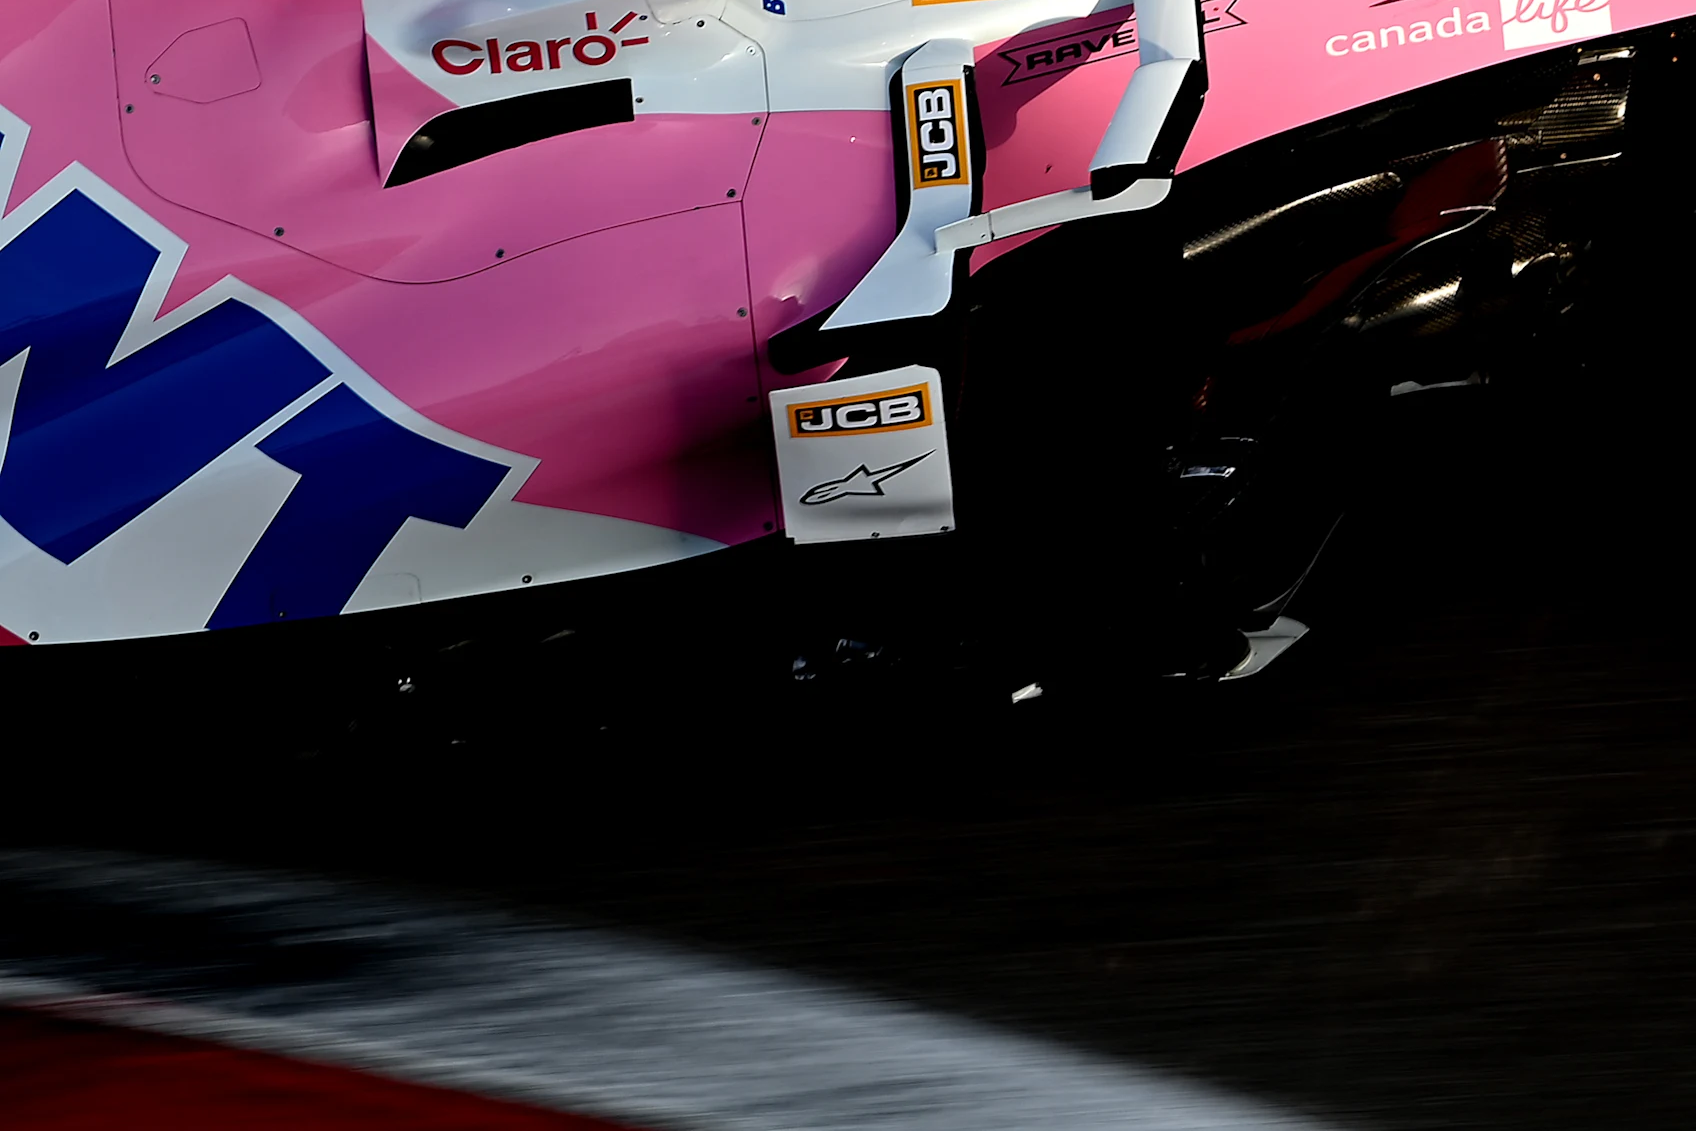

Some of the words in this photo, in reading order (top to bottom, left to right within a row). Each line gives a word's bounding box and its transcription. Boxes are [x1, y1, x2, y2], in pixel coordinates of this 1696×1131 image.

[431, 34, 617, 76] Claro
[1324, 5, 1491, 57] canada
[917, 88, 957, 179] JCB
[0, 132, 513, 630] WT
[800, 395, 923, 431] JCB
